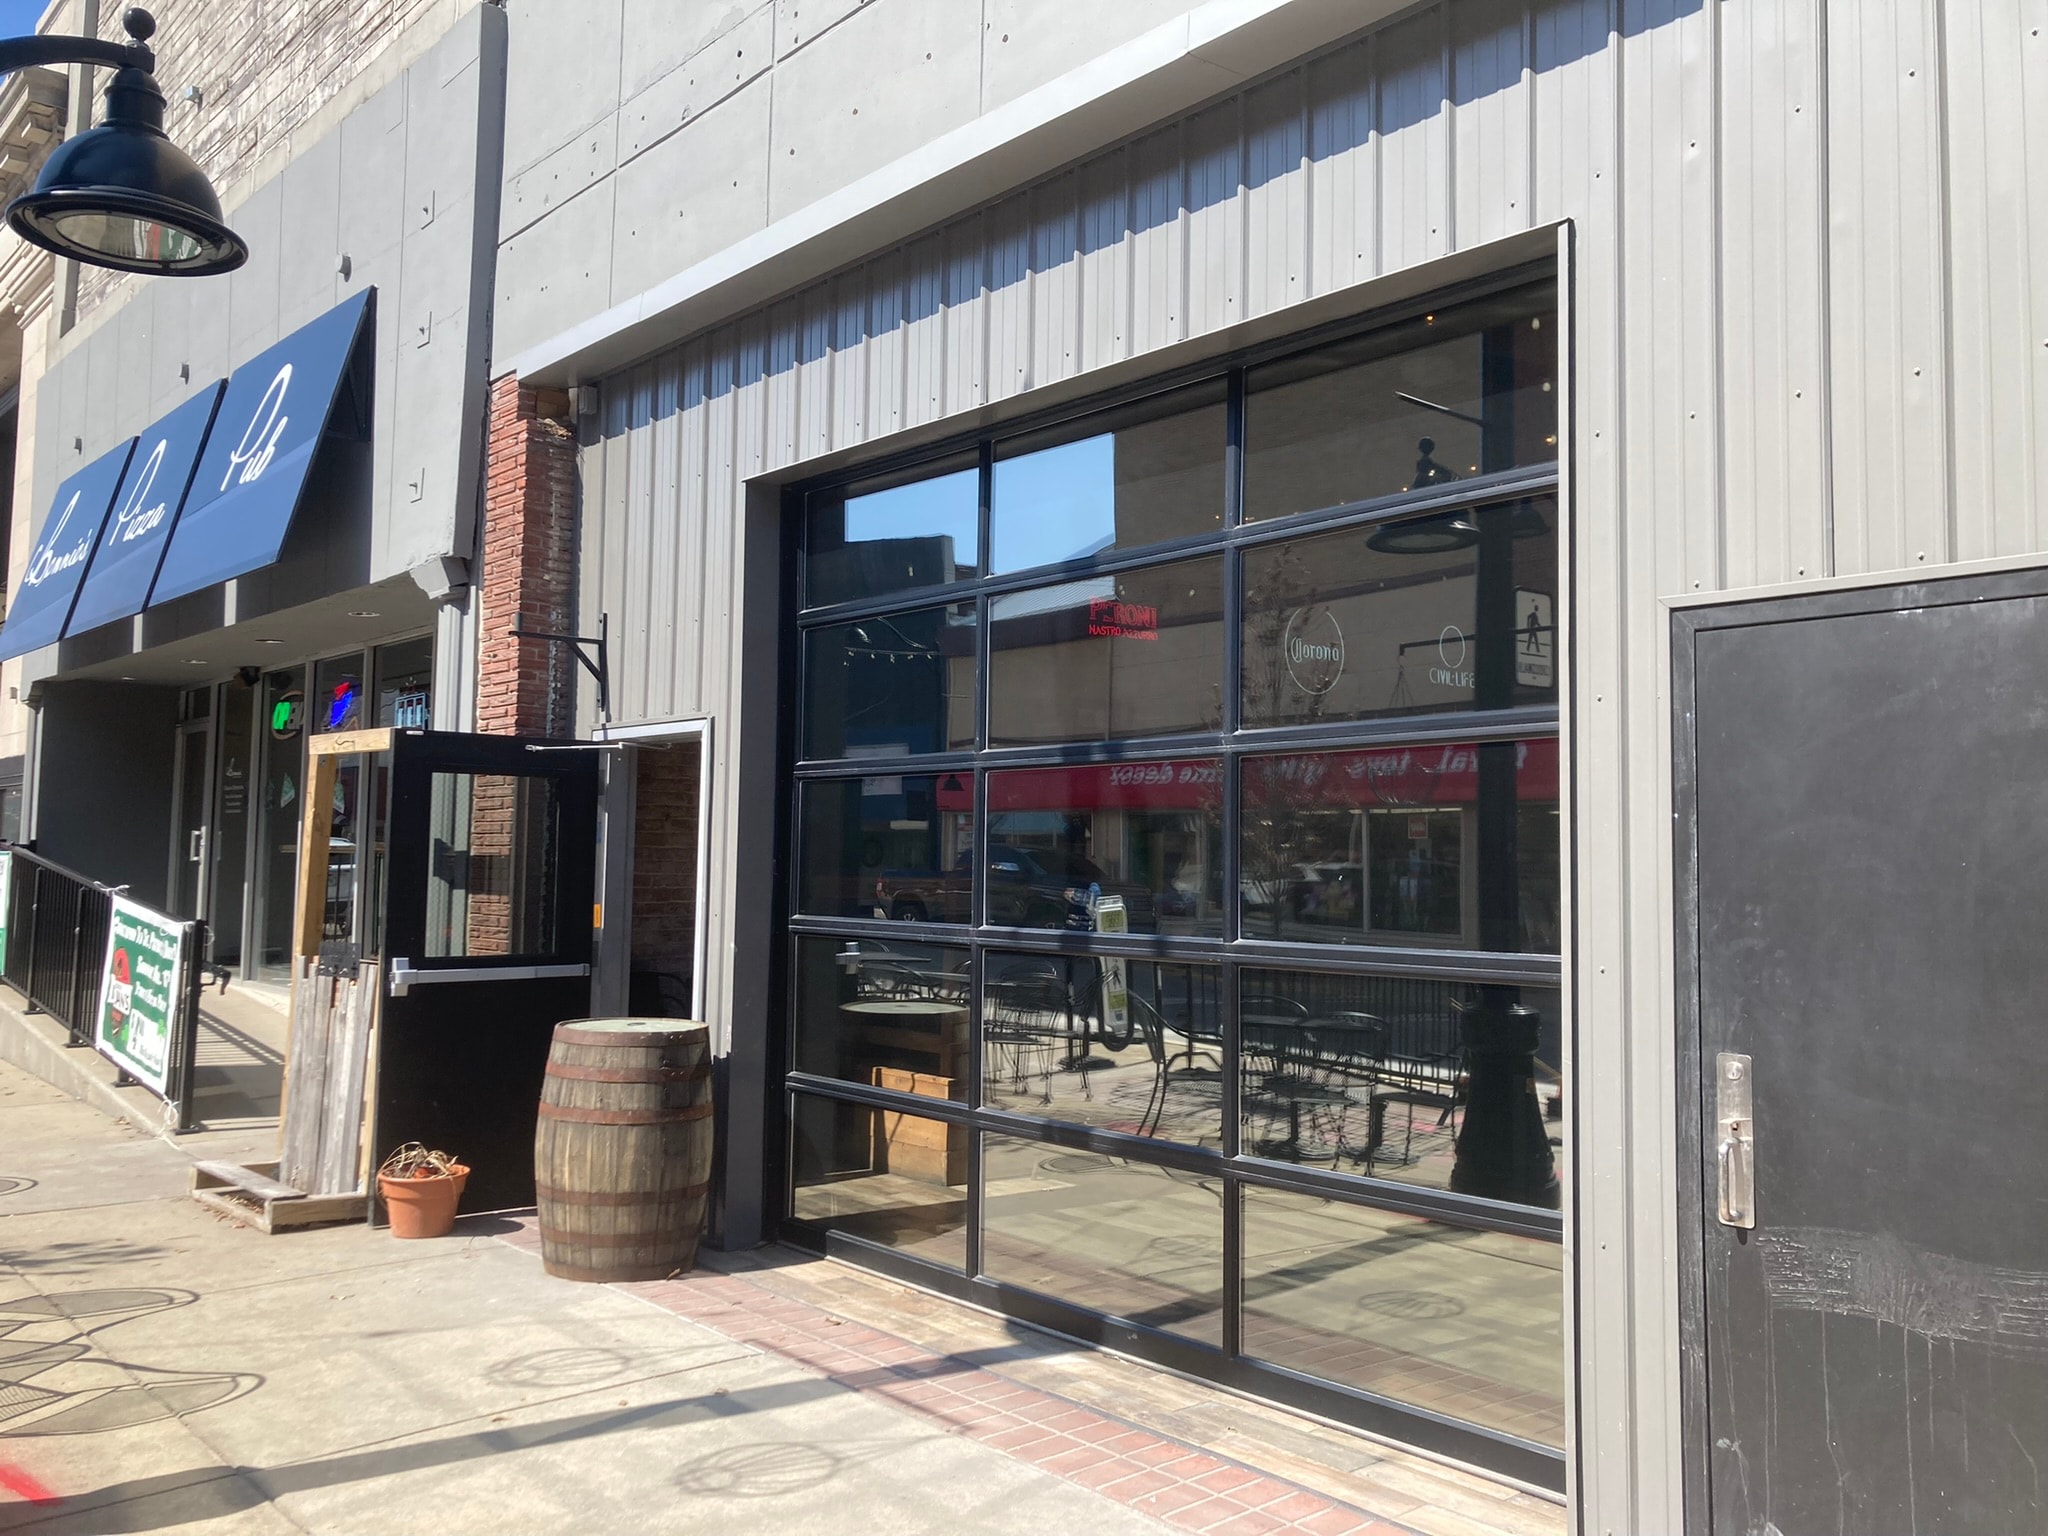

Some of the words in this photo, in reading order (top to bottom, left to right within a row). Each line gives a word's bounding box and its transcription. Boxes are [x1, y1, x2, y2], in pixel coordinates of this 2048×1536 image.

[109, 438, 165, 546] Pizza
[220, 363, 293, 492] Pub
[1089, 624, 1121, 637] NASTRO
[1122, 629, 1158, 641] AZZURRO
[1290, 635, 1340, 664] Corona
